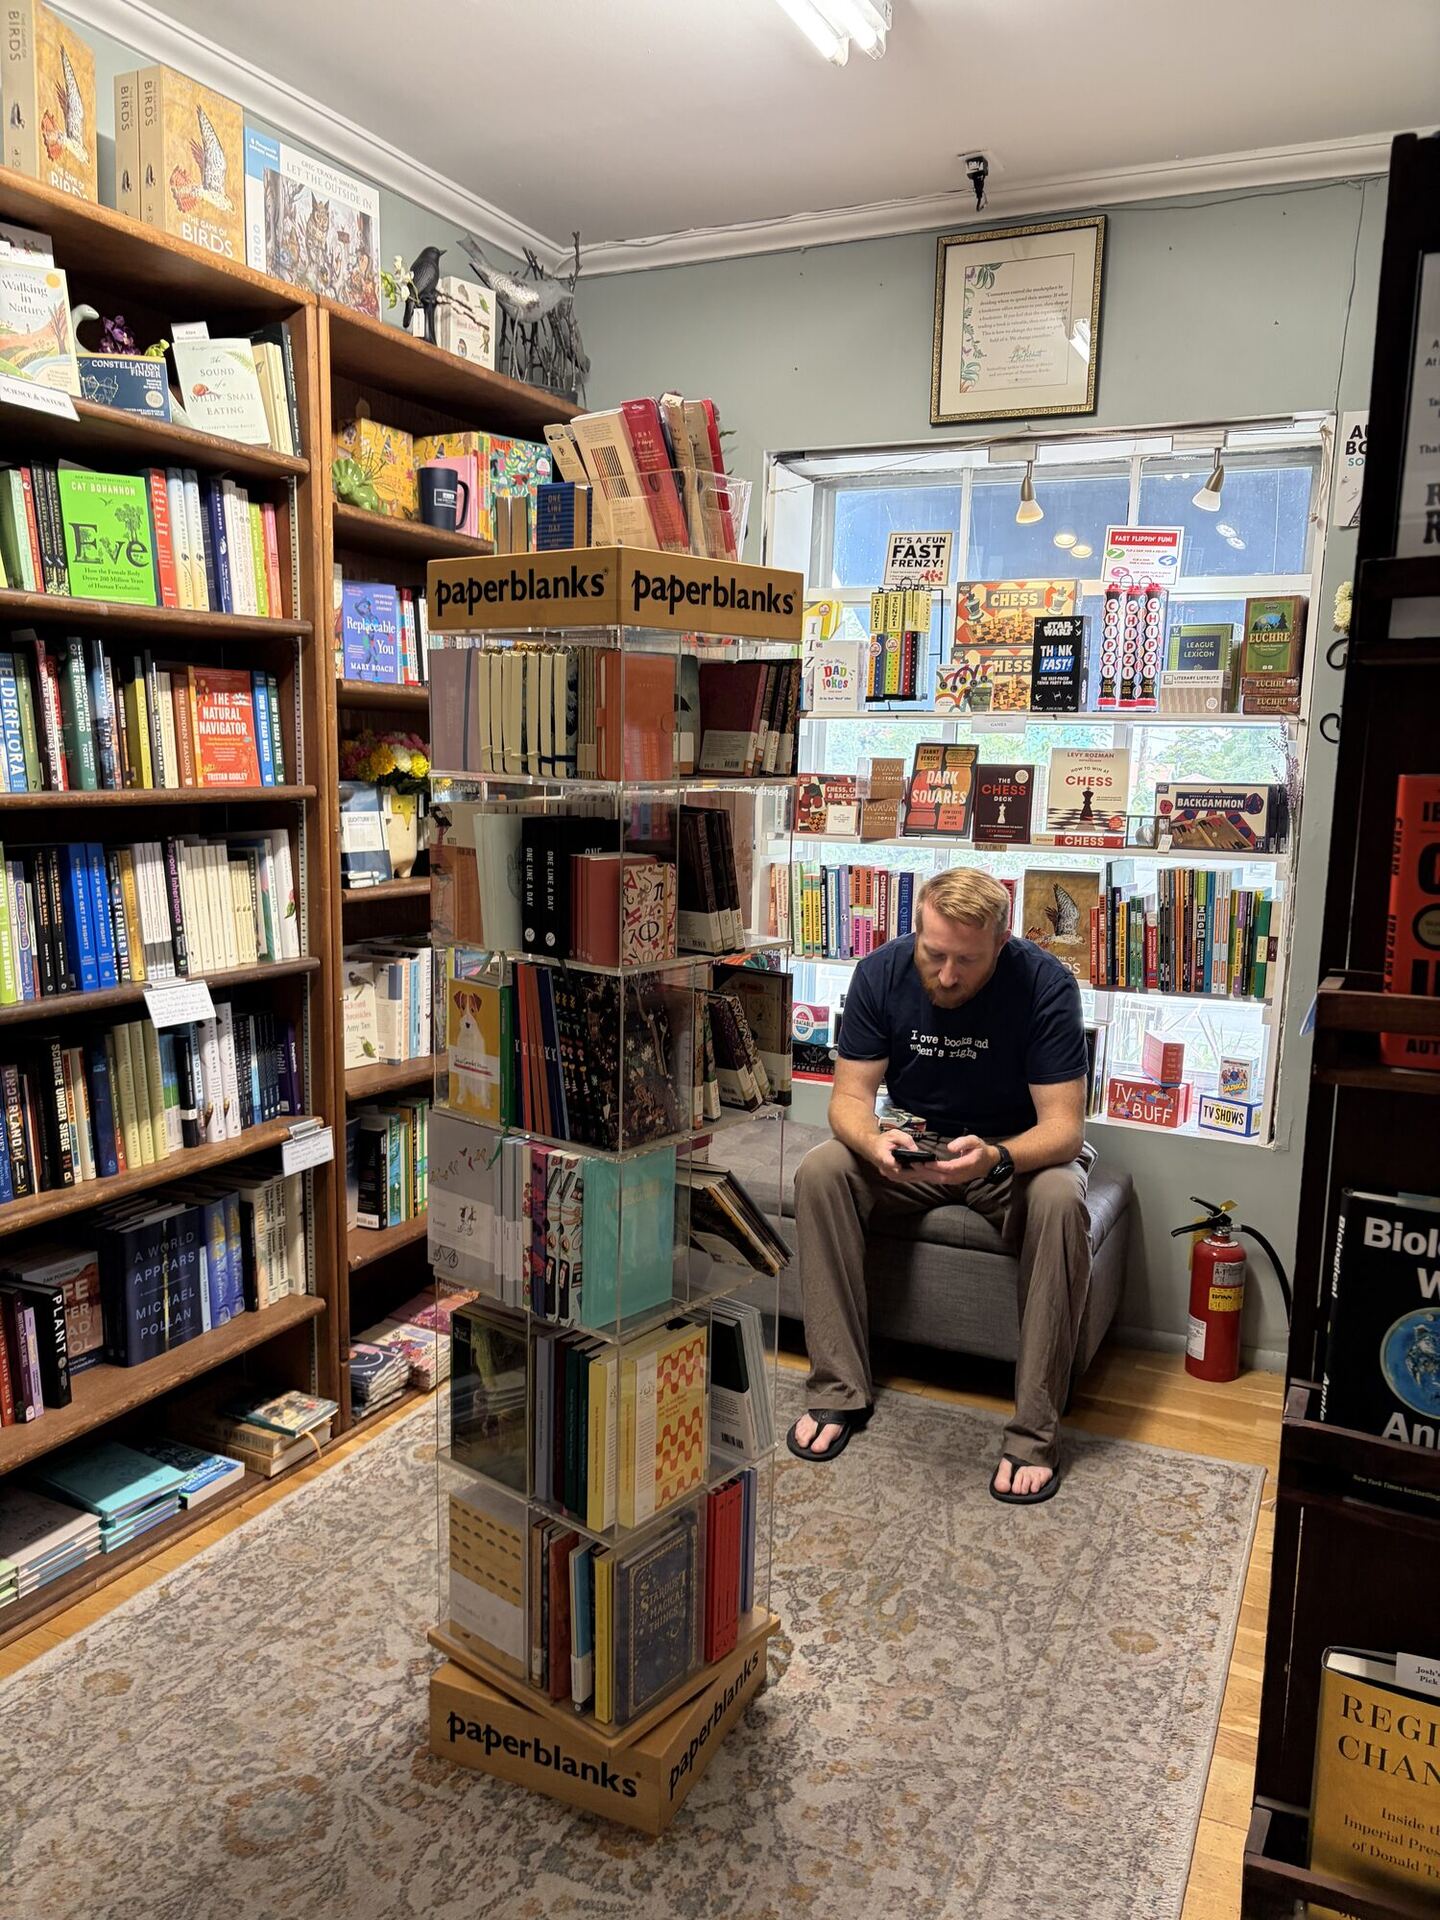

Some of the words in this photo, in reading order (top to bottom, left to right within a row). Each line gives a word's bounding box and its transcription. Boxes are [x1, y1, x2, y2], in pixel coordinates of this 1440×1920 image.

[8, 11, 21, 61] BIRDS
[121, 85, 129, 131] BIRDS
[144, 81, 153, 126] BIRDS
[286, 162, 301, 177] LET
[306, 173, 322, 187] THE
[325, 180, 359, 206] OUTSIDE
[362, 200, 372, 209] IN
[186, 216, 199, 227] THE
[200, 220, 218, 234] GAME
[219, 227, 227, 235] OF
[182, 222, 233, 258] BIRDS
[1, 280, 48, 297] Walking
[21, 294, 31, 304] in
[9, 303, 46, 316] Nature
[92, 360, 160, 371] CONSTELLATION
[131, 368, 161, 378] FINDER
[200, 368, 234, 376] SOUND
[3, 387, 32, 398] SCIENCE
[33, 392, 39, 401] &
[40, 394, 68, 408] NATURE
[207, 408, 244, 416] EATING
[91, 484, 135, 496] BOHANNON
[548, 524, 561, 532] DAY
[69, 523, 149, 567] Eve
[1132, 535, 1156, 543] FLIPPIN'
[893, 545, 945, 558] FAST
[435, 565, 604, 617] paperblanks
[632, 569, 793, 616] paperblanks
[990, 593, 1038, 606] CHESS
[346, 616, 396, 634] Replaceable
[1043, 627, 1073, 636] WARS
[1047, 621, 1072, 629] STAR
[1105, 602, 1115, 676] CHIPZI
[1125, 603, 1136, 678] CHIPZI
[1147, 601, 1157, 676] CHIPZI
[1249, 632, 1291, 643] EUCHRE
[70, 644, 77, 655] OF
[377, 640, 394, 655] You
[71, 659, 80, 672] THE
[351, 662, 369, 670] MARY
[372, 663, 394, 673] ROACH
[824, 665, 847, 677] DAD
[1042, 658, 1072, 671] FAST!
[73, 675, 83, 708] FUNGAL
[1255, 679, 1285, 687] EUCHRE
[213, 693, 230, 705] THE
[1257, 697, 1287, 705] EUCHRE
[0, 668, 25, 775] ELDERFLORA
[78, 711, 86, 732] KIND
[179, 707, 188, 739] HIDDEN
[203, 707, 241, 720] NATURAL
[200, 722, 247, 735] NAVIGATOR
[260, 722, 268, 738] READ
[182, 741, 191, 775] SEASONS
[262, 740, 270, 762] WATER
[207, 773, 228, 781] TRISTAN
[229, 773, 248, 781] GOOLEY
[926, 770, 960, 785] DARK
[1066, 776, 1113, 786] CHESS
[911, 789, 968, 804] SQUARES
[981, 784, 1026, 795] CHESS
[1177, 798, 1244, 808] BACKGAMMON
[1065, 836, 1104, 846] CHESS
[167, 843, 177, 875] Beyond
[79, 888, 84, 900] WE
[171, 877, 182, 924] Inheritance
[96, 886, 101, 898] WE
[99, 923, 107, 947] RIGHT?
[1197, 906, 1205, 938] MEGA
[115, 905, 126, 948] FEATHER
[119, 951, 131, 980] THIEF
[911, 1030, 918, 1040] I
[920, 1035, 938, 1044] ove
[944, 1036, 972, 1047] books
[50, 1044, 64, 1086] SCIENCE
[194, 1059, 199, 1069] TO
[1115, 1083, 1132, 1102] TV
[4, 1070, 23, 1147] UNDERLAND
[55, 1088, 68, 1121] UNDER
[1132, 1103, 1173, 1124] BUFF
[1203, 1105, 1214, 1118] TV
[1214, 1107, 1244, 1126] SHOWS
[60, 1123, 71, 1151] SIEGE
[134, 1251, 143, 1264] A
[149, 1232, 194, 1259] WORLD
[1330, 1215, 1346, 1299] Biological
[52, 1294, 67, 1353] PLANT
[1319, 1372, 1331, 1423] Annie
[651, 1589, 685, 1619] MAGICAL
[651, 1606, 678, 1632] THINGS
[1419, 1675, 1438, 1686] Pick
[668, 1650, 760, 1801] paperblanks
[447, 1711, 637, 1798] paperblanks
[1343, 1813, 1404, 1847] Imperial
[1352, 1841, 1366, 1857] of
[1368, 1844, 1420, 1873] Donald
